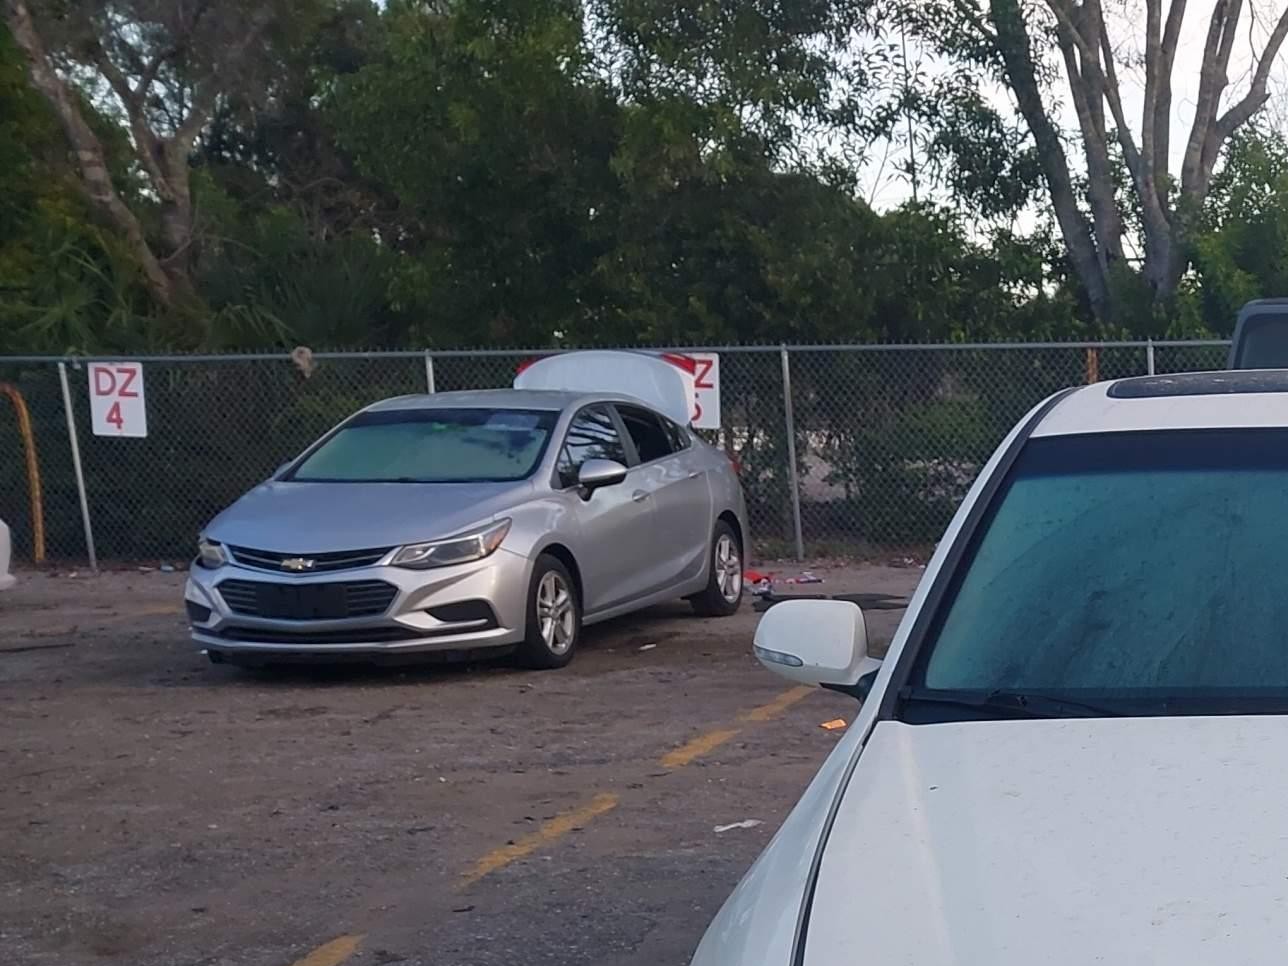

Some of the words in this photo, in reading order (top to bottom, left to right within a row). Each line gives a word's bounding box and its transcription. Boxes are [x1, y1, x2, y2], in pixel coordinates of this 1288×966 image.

[94, 367, 138, 397] DZ
[694, 359, 714, 389] Z
[106, 401, 123, 429] 4
